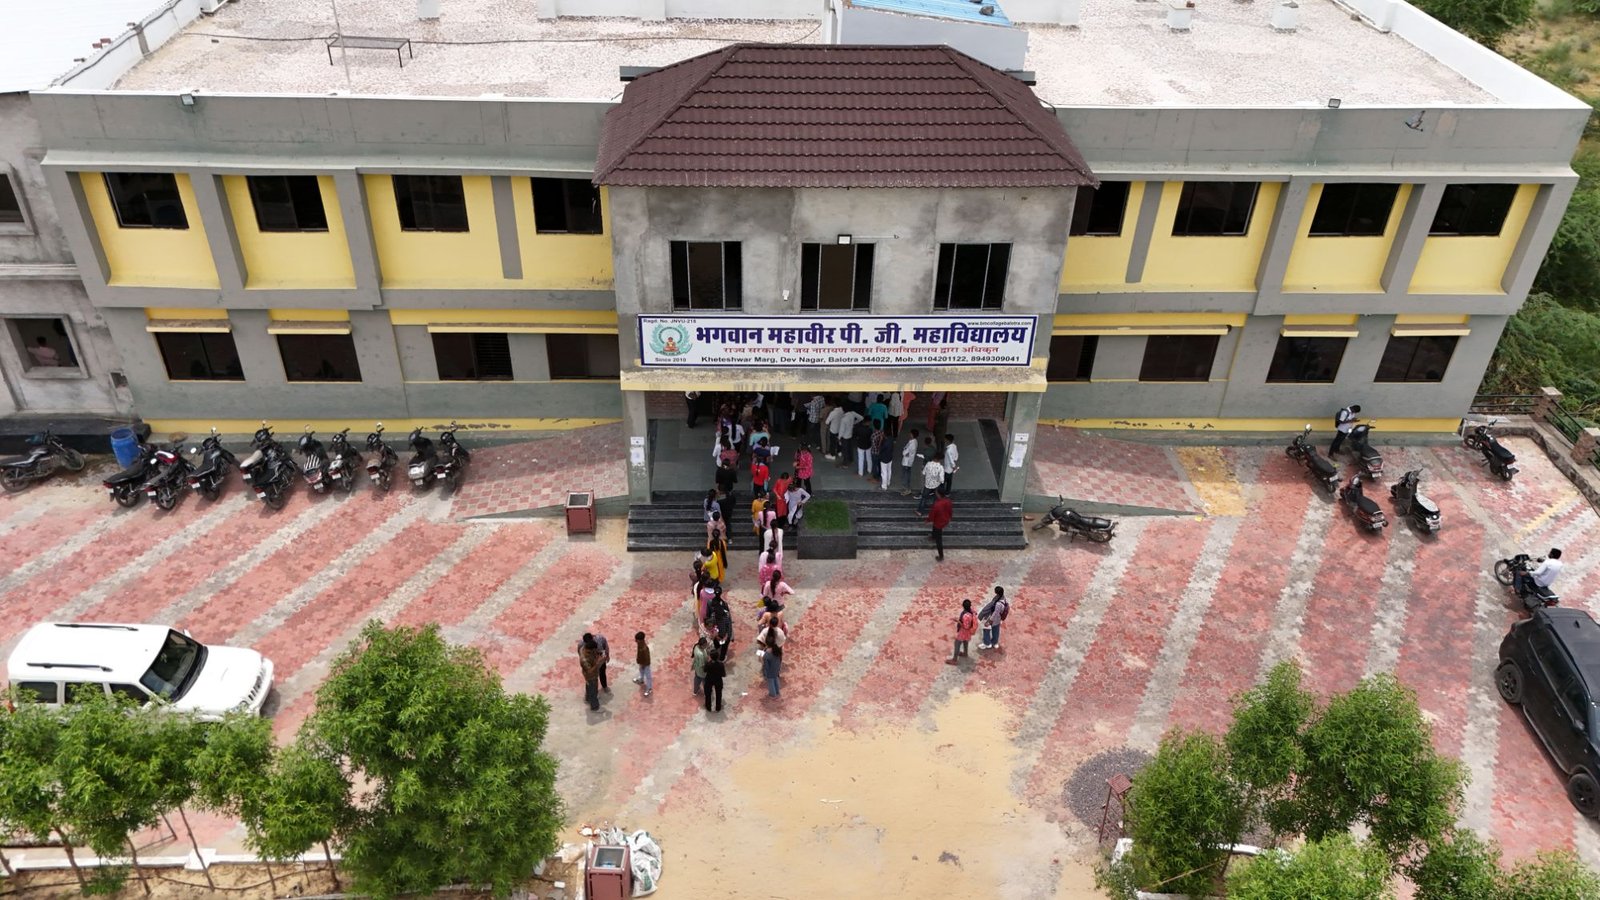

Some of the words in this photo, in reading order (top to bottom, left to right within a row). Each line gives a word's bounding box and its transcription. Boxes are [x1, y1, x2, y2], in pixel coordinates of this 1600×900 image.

[696, 327, 764, 344] भगवान
[767, 322, 836, 344] महावीर
[840, 322, 868, 344] पी.
[874, 322, 906, 344] जी.
[912, 322, 1028, 344] महाविद्यालय
[962, 346, 999, 354] अधिकृत
